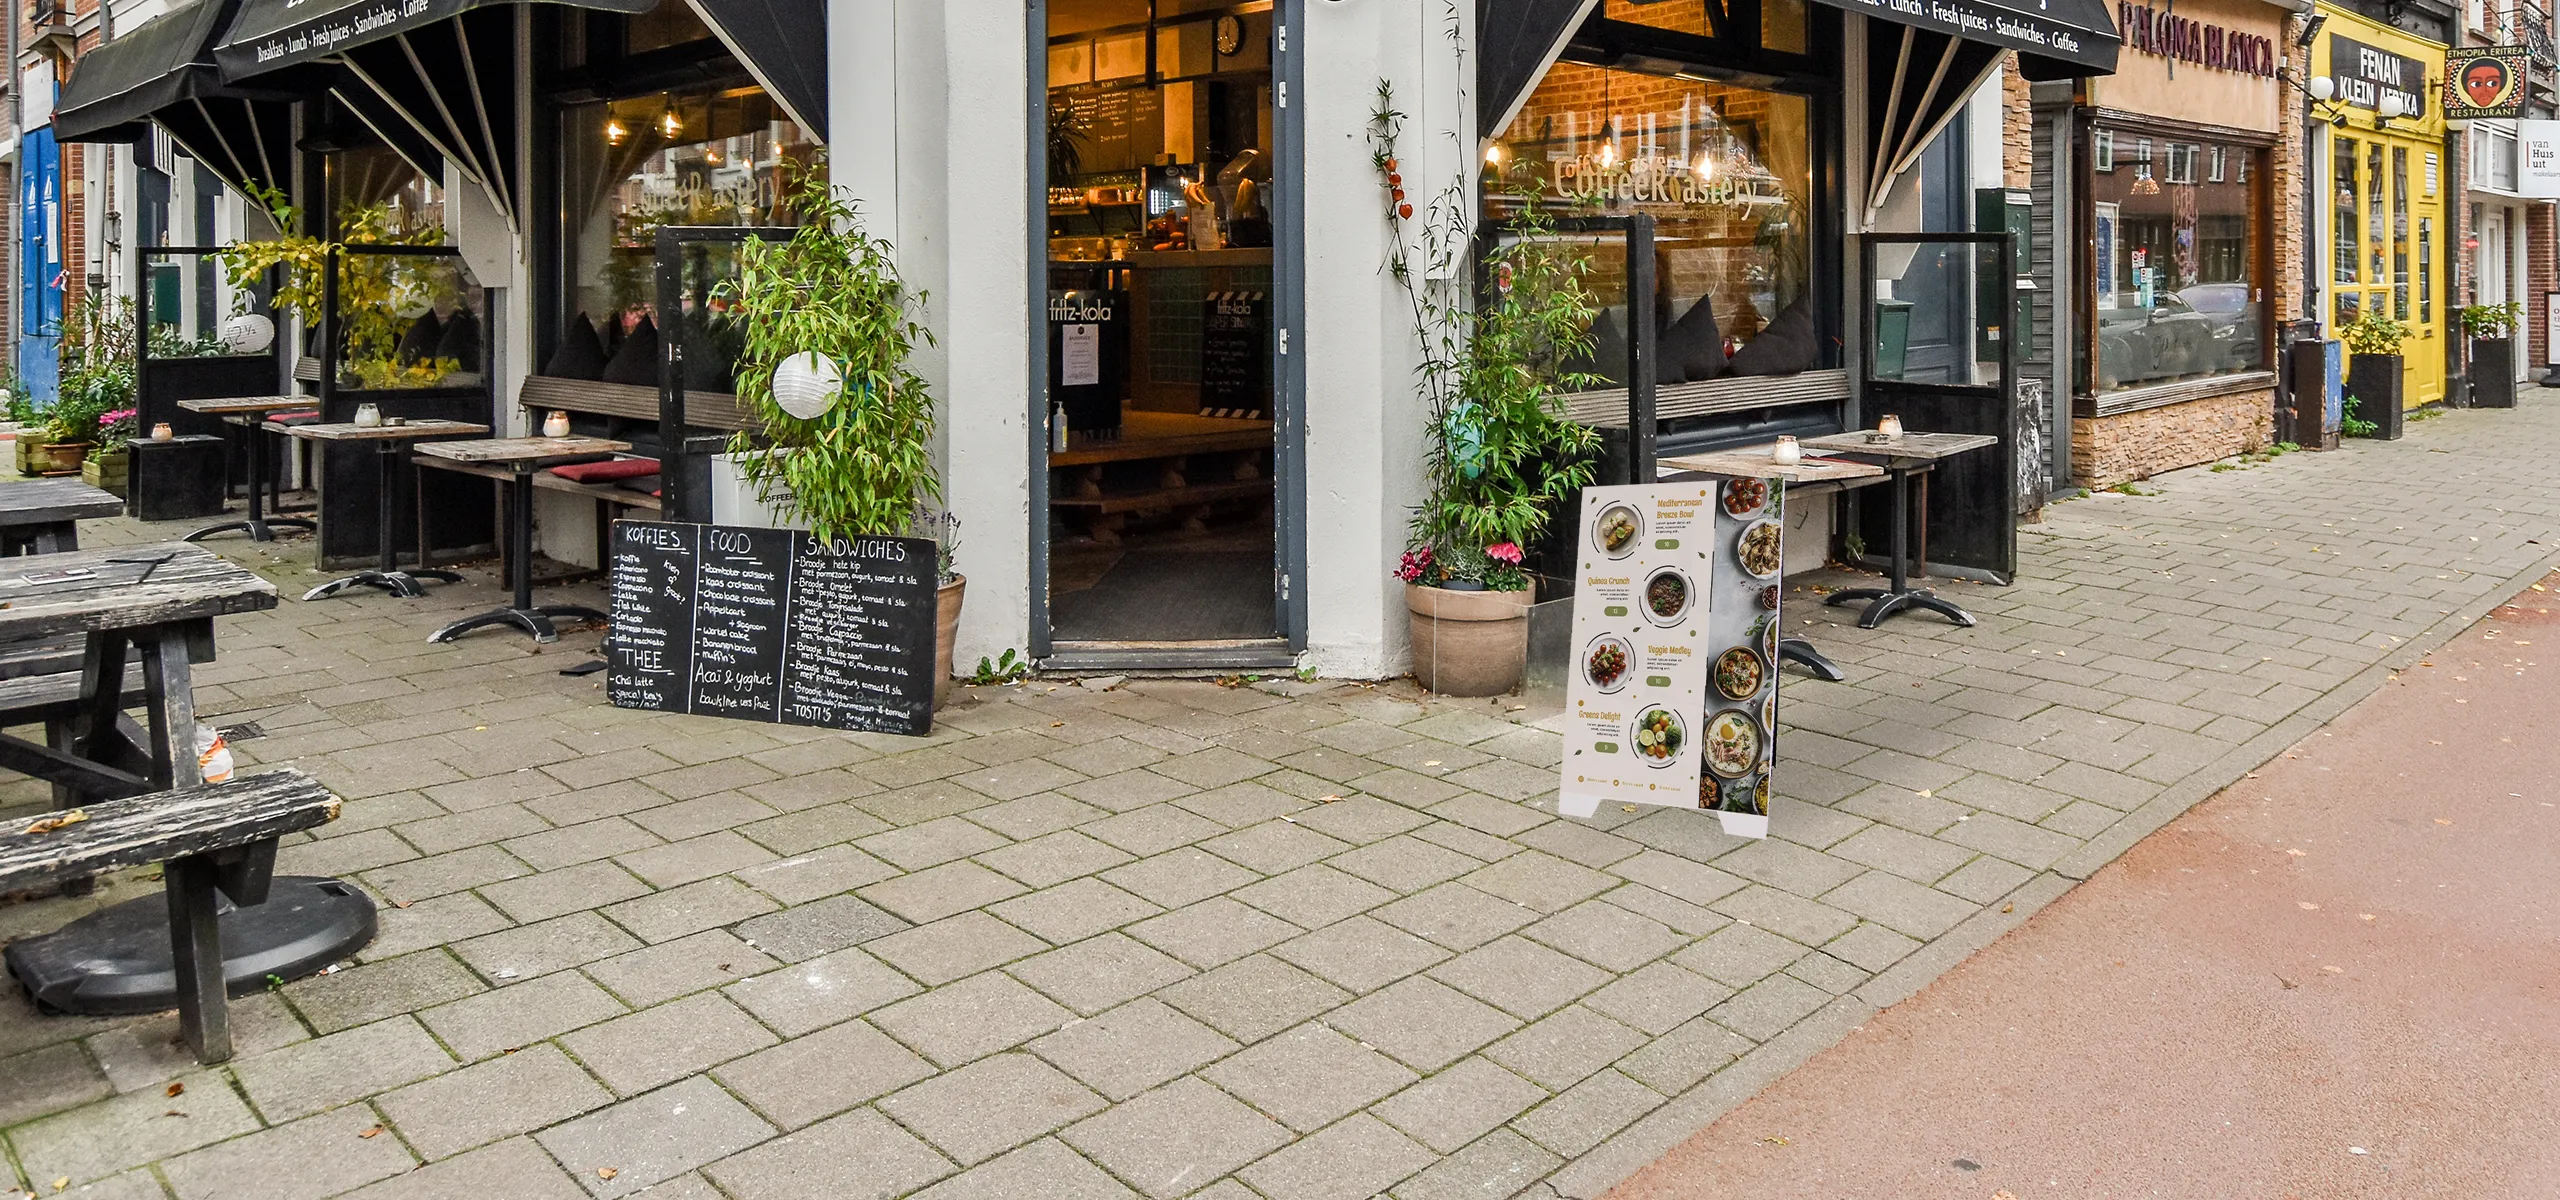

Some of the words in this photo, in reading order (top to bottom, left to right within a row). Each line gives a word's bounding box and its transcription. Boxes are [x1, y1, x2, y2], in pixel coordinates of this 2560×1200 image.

[257, 38, 284, 63] Breakfast
[288, 31, 308, 54] Lunch
[311, 24, 330, 48] Fresh
[329, 20, 350, 50] juices
[354, 4, 397, 35] Sandwiches
[403, 0, 428, 17] Coffee
[1890, 0, 1923, 16] Lunch
[1932, 1, 1959, 25] Fresh
[1959, 7, 1988, 32] juices
[1995, 16, 2045, 45] Sandwiches
[2052, 31, 2079, 53] Coffee
[2118, 1, 2203, 64] PALOMA
[2204, 24, 2274, 78] BLANCA
[2447, 49, 2487, 58] ETHIOPIA
[2490, 46, 2525, 56] ERITREA
[2360, 47, 2400, 86] FENAN
[2340, 75, 2375, 106] KLEIN
[2451, 107, 2517, 117] RESTAURANT
[2532, 140, 2549, 148] van
[2532, 149, 2554, 158] Huis
[2532, 160, 2546, 168] uit
[1049, 298, 1111, 320] fritz-kola
[1657, 511, 1678, 519] Breeze
[1679, 510, 1694, 518] Bowl
[710, 530, 751, 554] FOOD
[805, 536, 905, 561] SANDWICHES
[800, 556, 826, 571] Broodje
[850, 561, 860, 573] kip
[799, 577, 824, 592] Broodje
[801, 569, 814, 577] met
[899, 575, 904, 583] &
[906, 575, 917, 585] sla
[1588, 576, 1607, 586] Quinoa
[1608, 577, 1630, 585] Crunch
[800, 596, 823, 610] Broodje
[895, 598, 906, 606] sla
[798, 621, 823, 635] Broodje
[878, 619, 889, 627] sla
[729, 631, 750, 641] cake
[797, 641, 822, 656] Broodje
[1648, 645, 1668, 656] Veggie
[1669, 646, 1691, 657] Medley
[618, 648, 662, 669] THEE
[795, 660, 820, 676] Broodje
[824, 665, 840, 677] Kaas
[897, 667, 908, 676] sla
[724, 670, 734, 684] &
[733, 670, 773, 692] yoghurt
[795, 681, 822, 697] Broodje
[884, 684, 890, 694] &
[891, 685, 902, 695] sla
[792, 703, 831, 722] TOSTI'S
[1579, 710, 1599, 719] Greens
[1600, 711, 1621, 722] Delight
